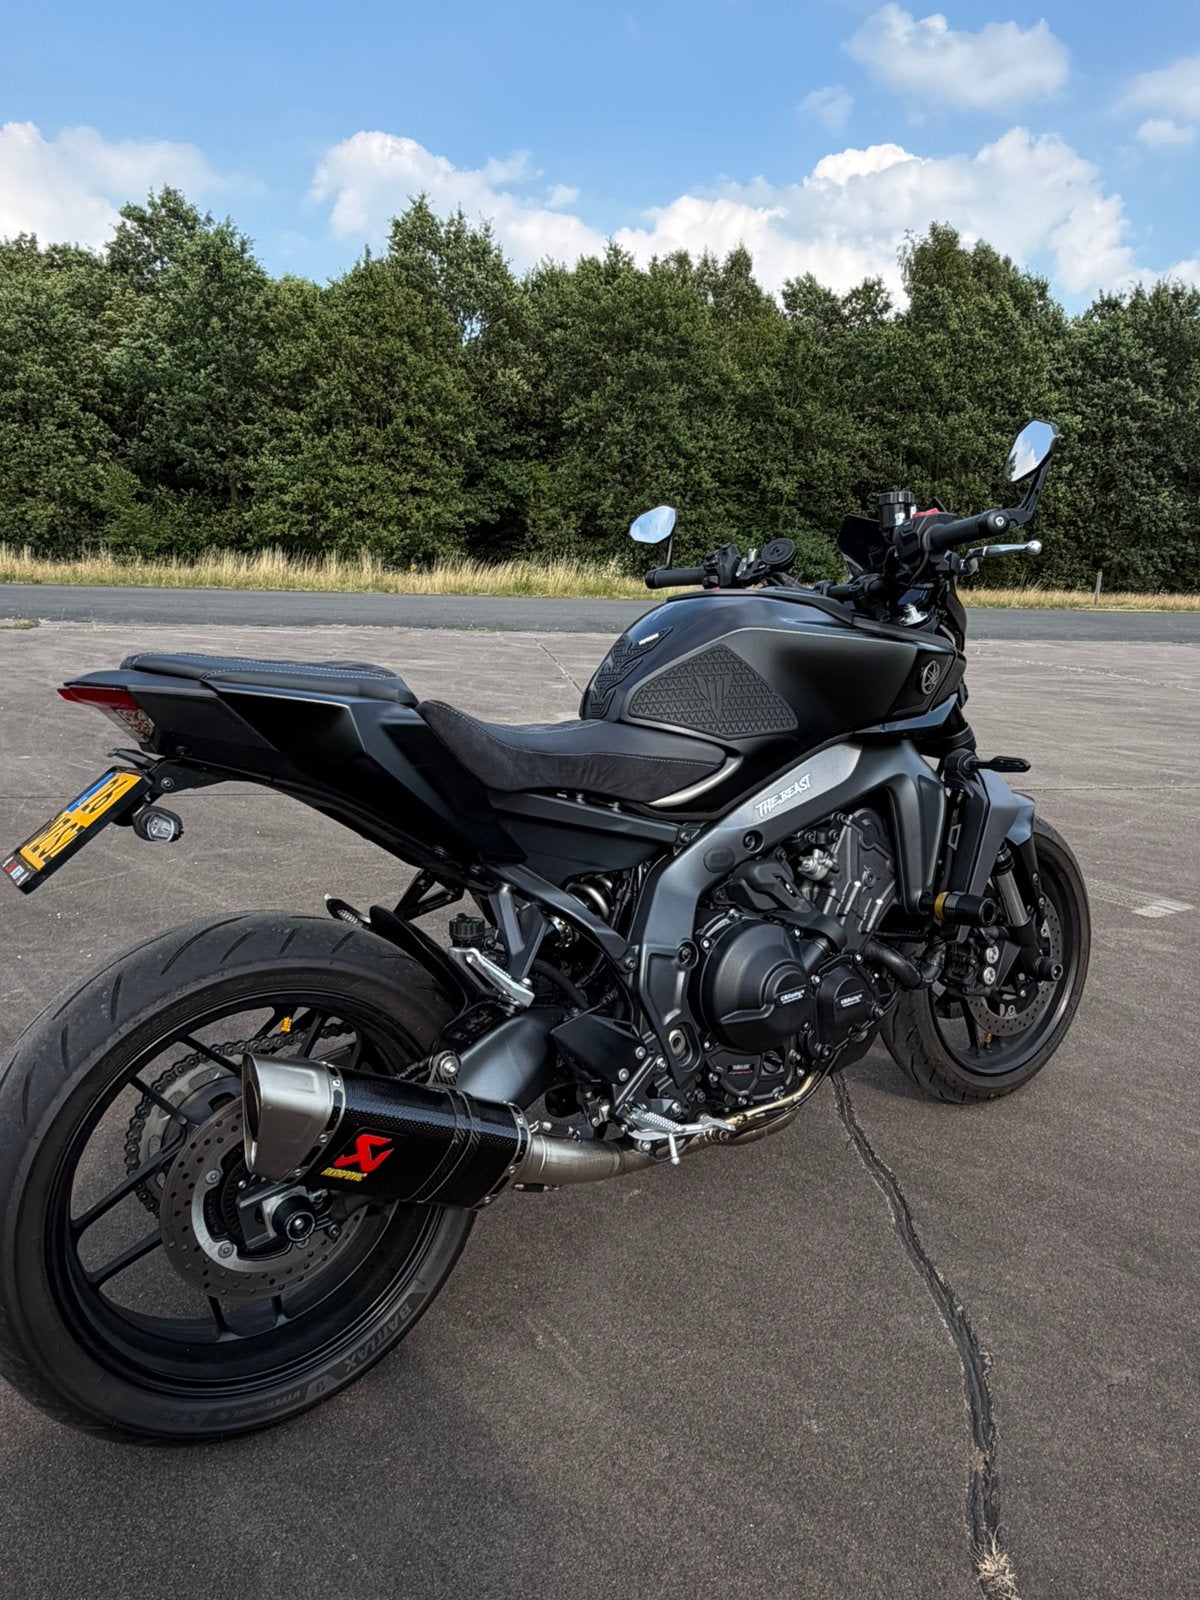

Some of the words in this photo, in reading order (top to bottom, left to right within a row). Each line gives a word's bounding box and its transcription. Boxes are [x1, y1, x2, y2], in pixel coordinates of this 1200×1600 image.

[754, 793, 779, 818] THE
[779, 773, 811, 803] BEAST
[344, 1303, 412, 1372] BATTLAX
